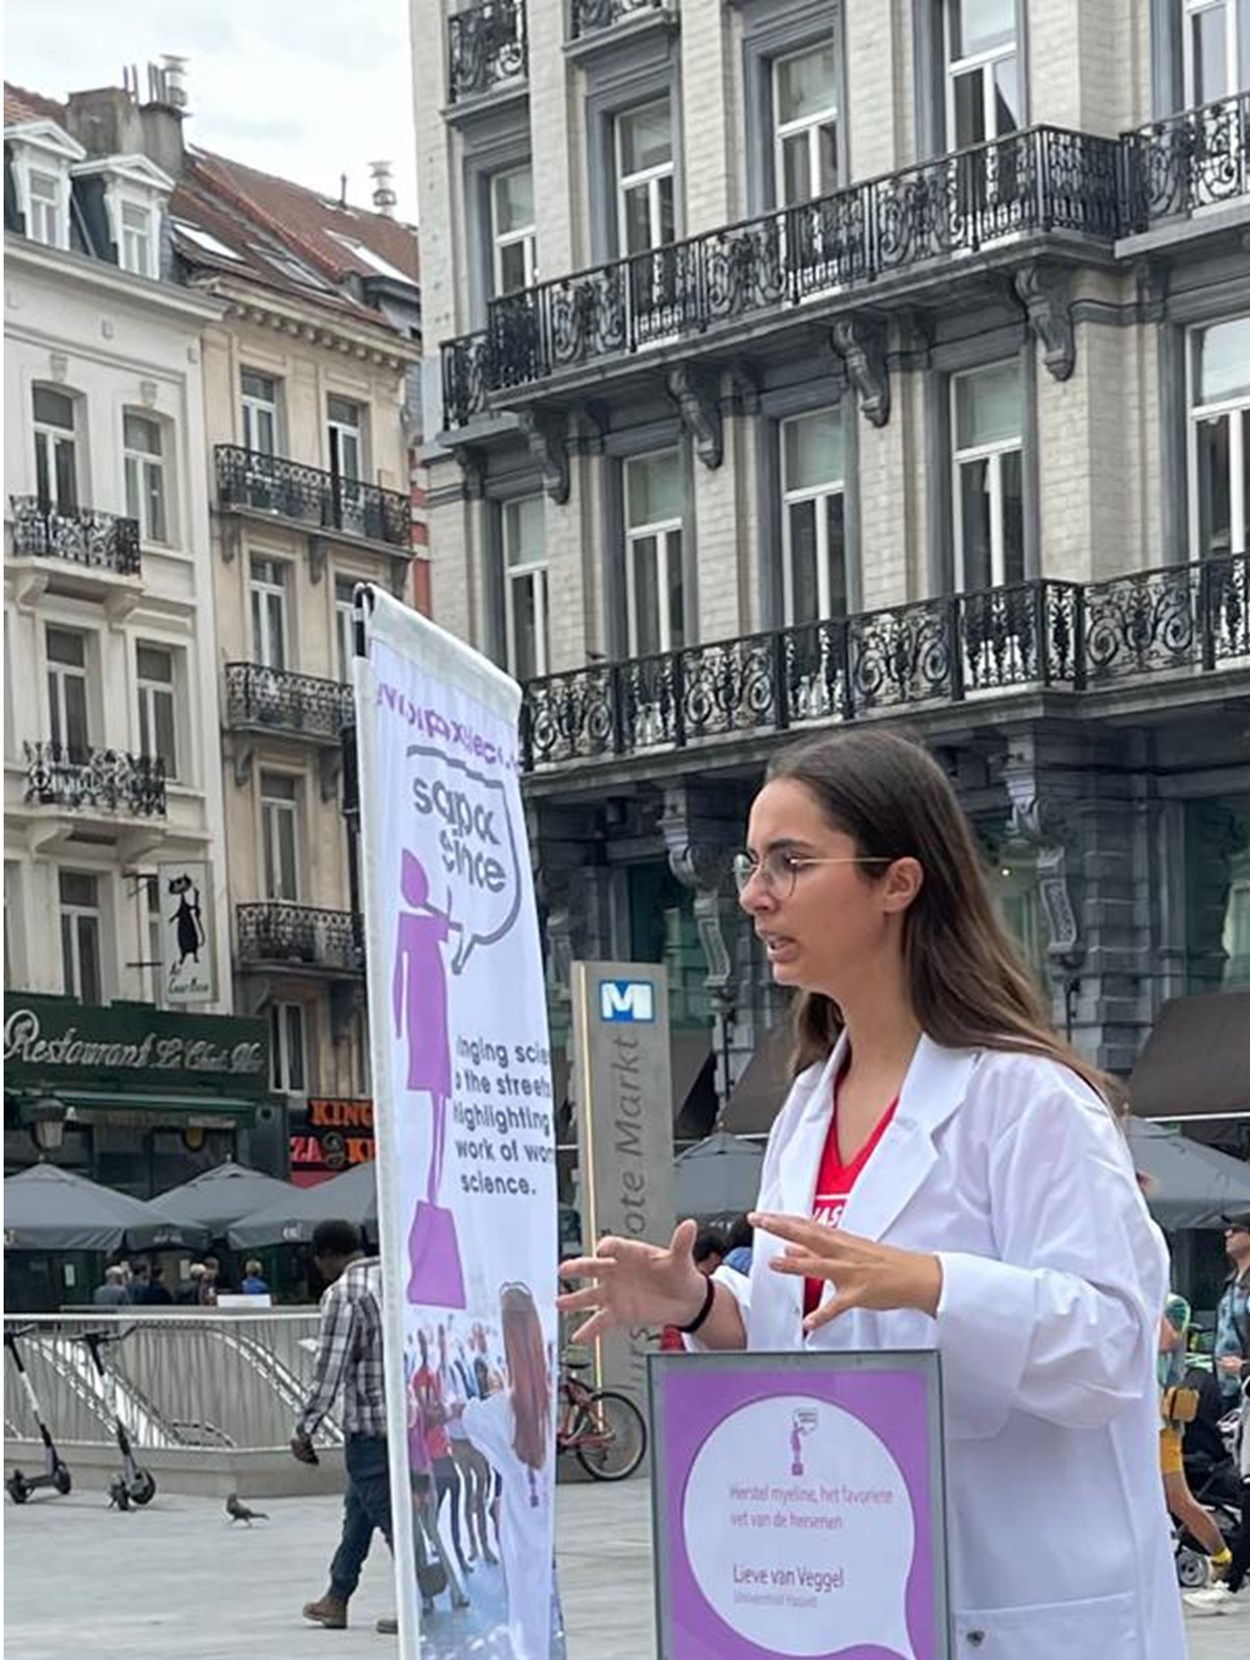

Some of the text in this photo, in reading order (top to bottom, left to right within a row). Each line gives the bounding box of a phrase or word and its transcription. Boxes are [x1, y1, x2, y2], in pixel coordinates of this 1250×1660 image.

[4, 1009, 156, 1067] Restaurant
[464, 1069, 491, 1094] the
[610, 1035, 646, 1235] ote Markt
[455, 1138, 496, 1162] work
[500, 1139, 519, 1162] of
[460, 1171, 536, 1196] science.
[733, 1564, 845, 1593] Lieve van Veggel
